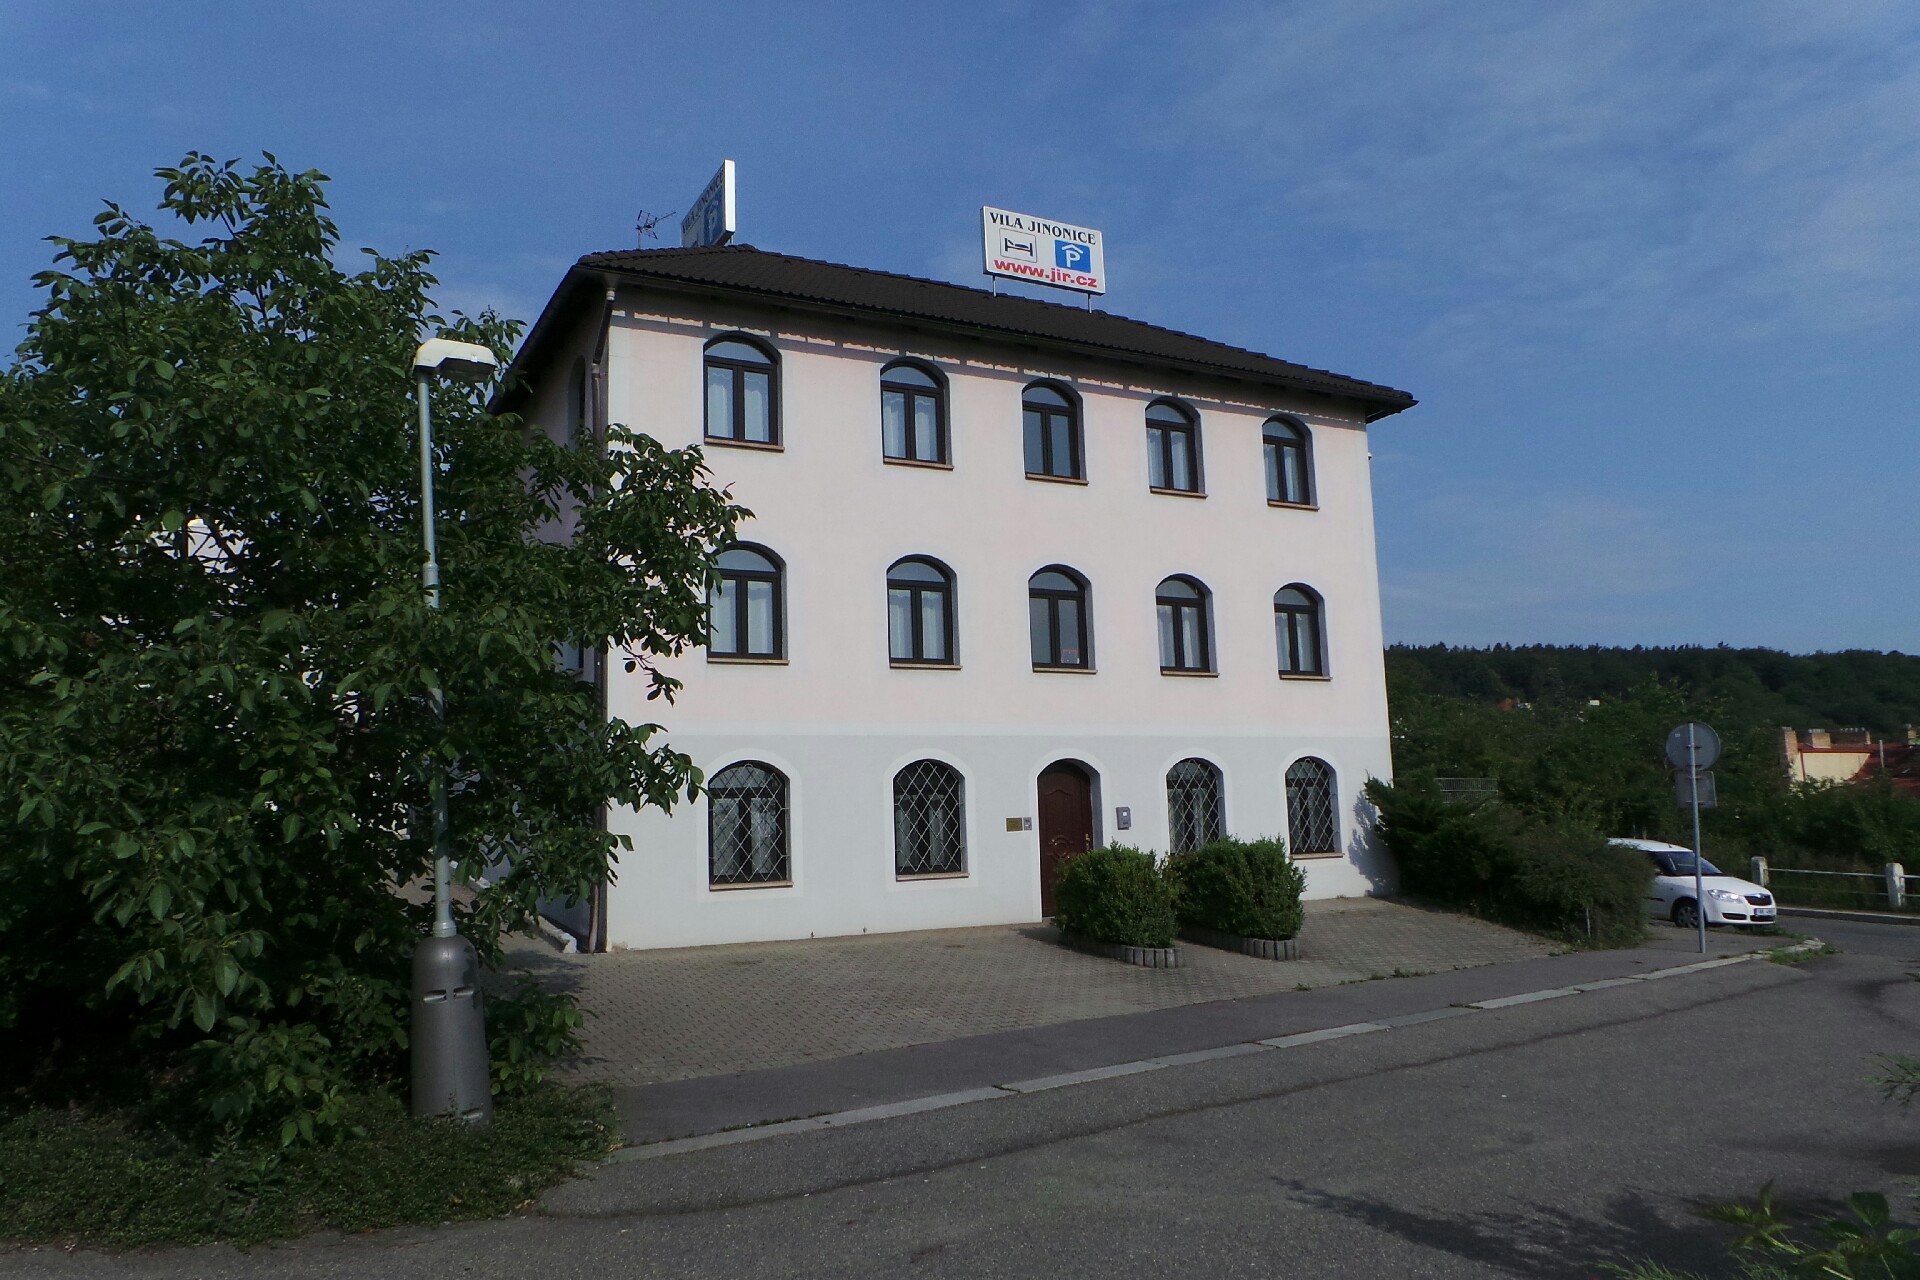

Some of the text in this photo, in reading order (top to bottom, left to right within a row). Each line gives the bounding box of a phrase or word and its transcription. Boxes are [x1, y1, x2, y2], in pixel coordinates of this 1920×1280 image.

[990, 212, 1096, 245] VILA JINONICE
[994, 259, 1097, 288] www.jir.cz
[1065, 250, 1081, 268] P
